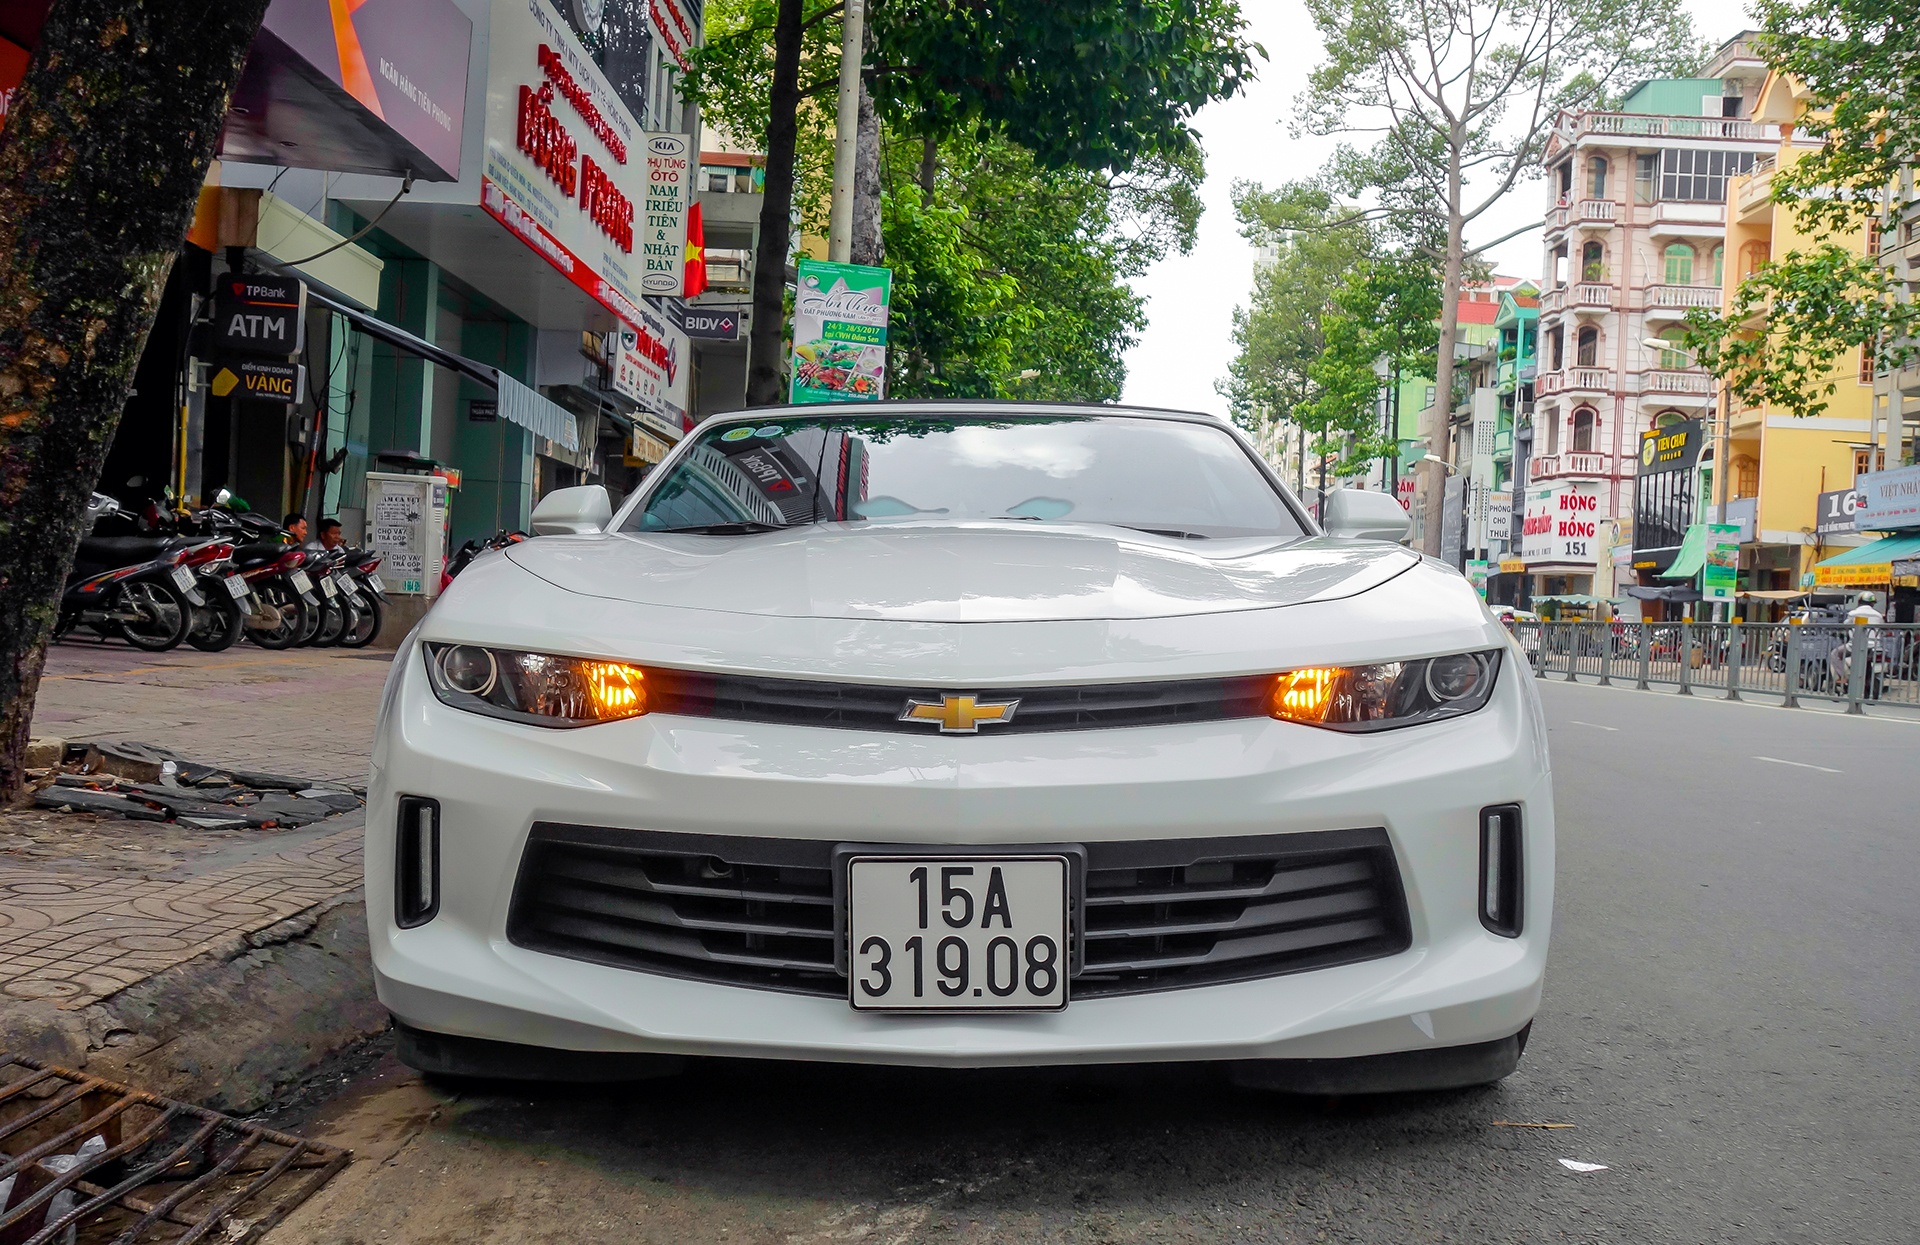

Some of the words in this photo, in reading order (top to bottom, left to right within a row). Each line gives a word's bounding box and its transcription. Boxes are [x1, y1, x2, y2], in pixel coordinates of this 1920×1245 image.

[380, 57, 399, 87] NGÂN
[399, 74, 417, 103] HÀNG
[431, 103, 451, 132] PHONG
[655, 141, 675, 151] KIA
[663, 155, 686, 170] TÙNG
[651, 169, 679, 183] ÔTÔ
[649, 184, 679, 197] NAM
[645, 197, 683, 213] TRIỀU
[648, 213, 677, 228] TIÊN
[656, 230, 666, 241] &
[643, 242, 679, 258] NHẬT
[646, 256, 673, 271] BẢN
[246, 285, 286, 298] TPBank
[685, 316, 719, 331] BIDV
[842, 312, 856, 320] NAM
[227, 313, 286, 340] ATM
[827, 322, 842, 331] 24/5
[846, 324, 880, 334] 28/5/2017
[867, 335, 879, 343] Sen
[245, 372, 293, 394] VÀNG
[1901, 476, 1920, 497] NHẬ
[1560, 485, 1597, 511] HỒNG
[1490, 503, 1511, 513] PHÒNG
[1493, 517, 1506, 525] CHO
[1559, 512, 1595, 538] HỒNG
[1490, 528, 1509, 538] THUÊ
[1565, 541, 1587, 556] 151
[909, 866, 1012, 929] 15A
[859, 936, 1057, 998] 319.08
